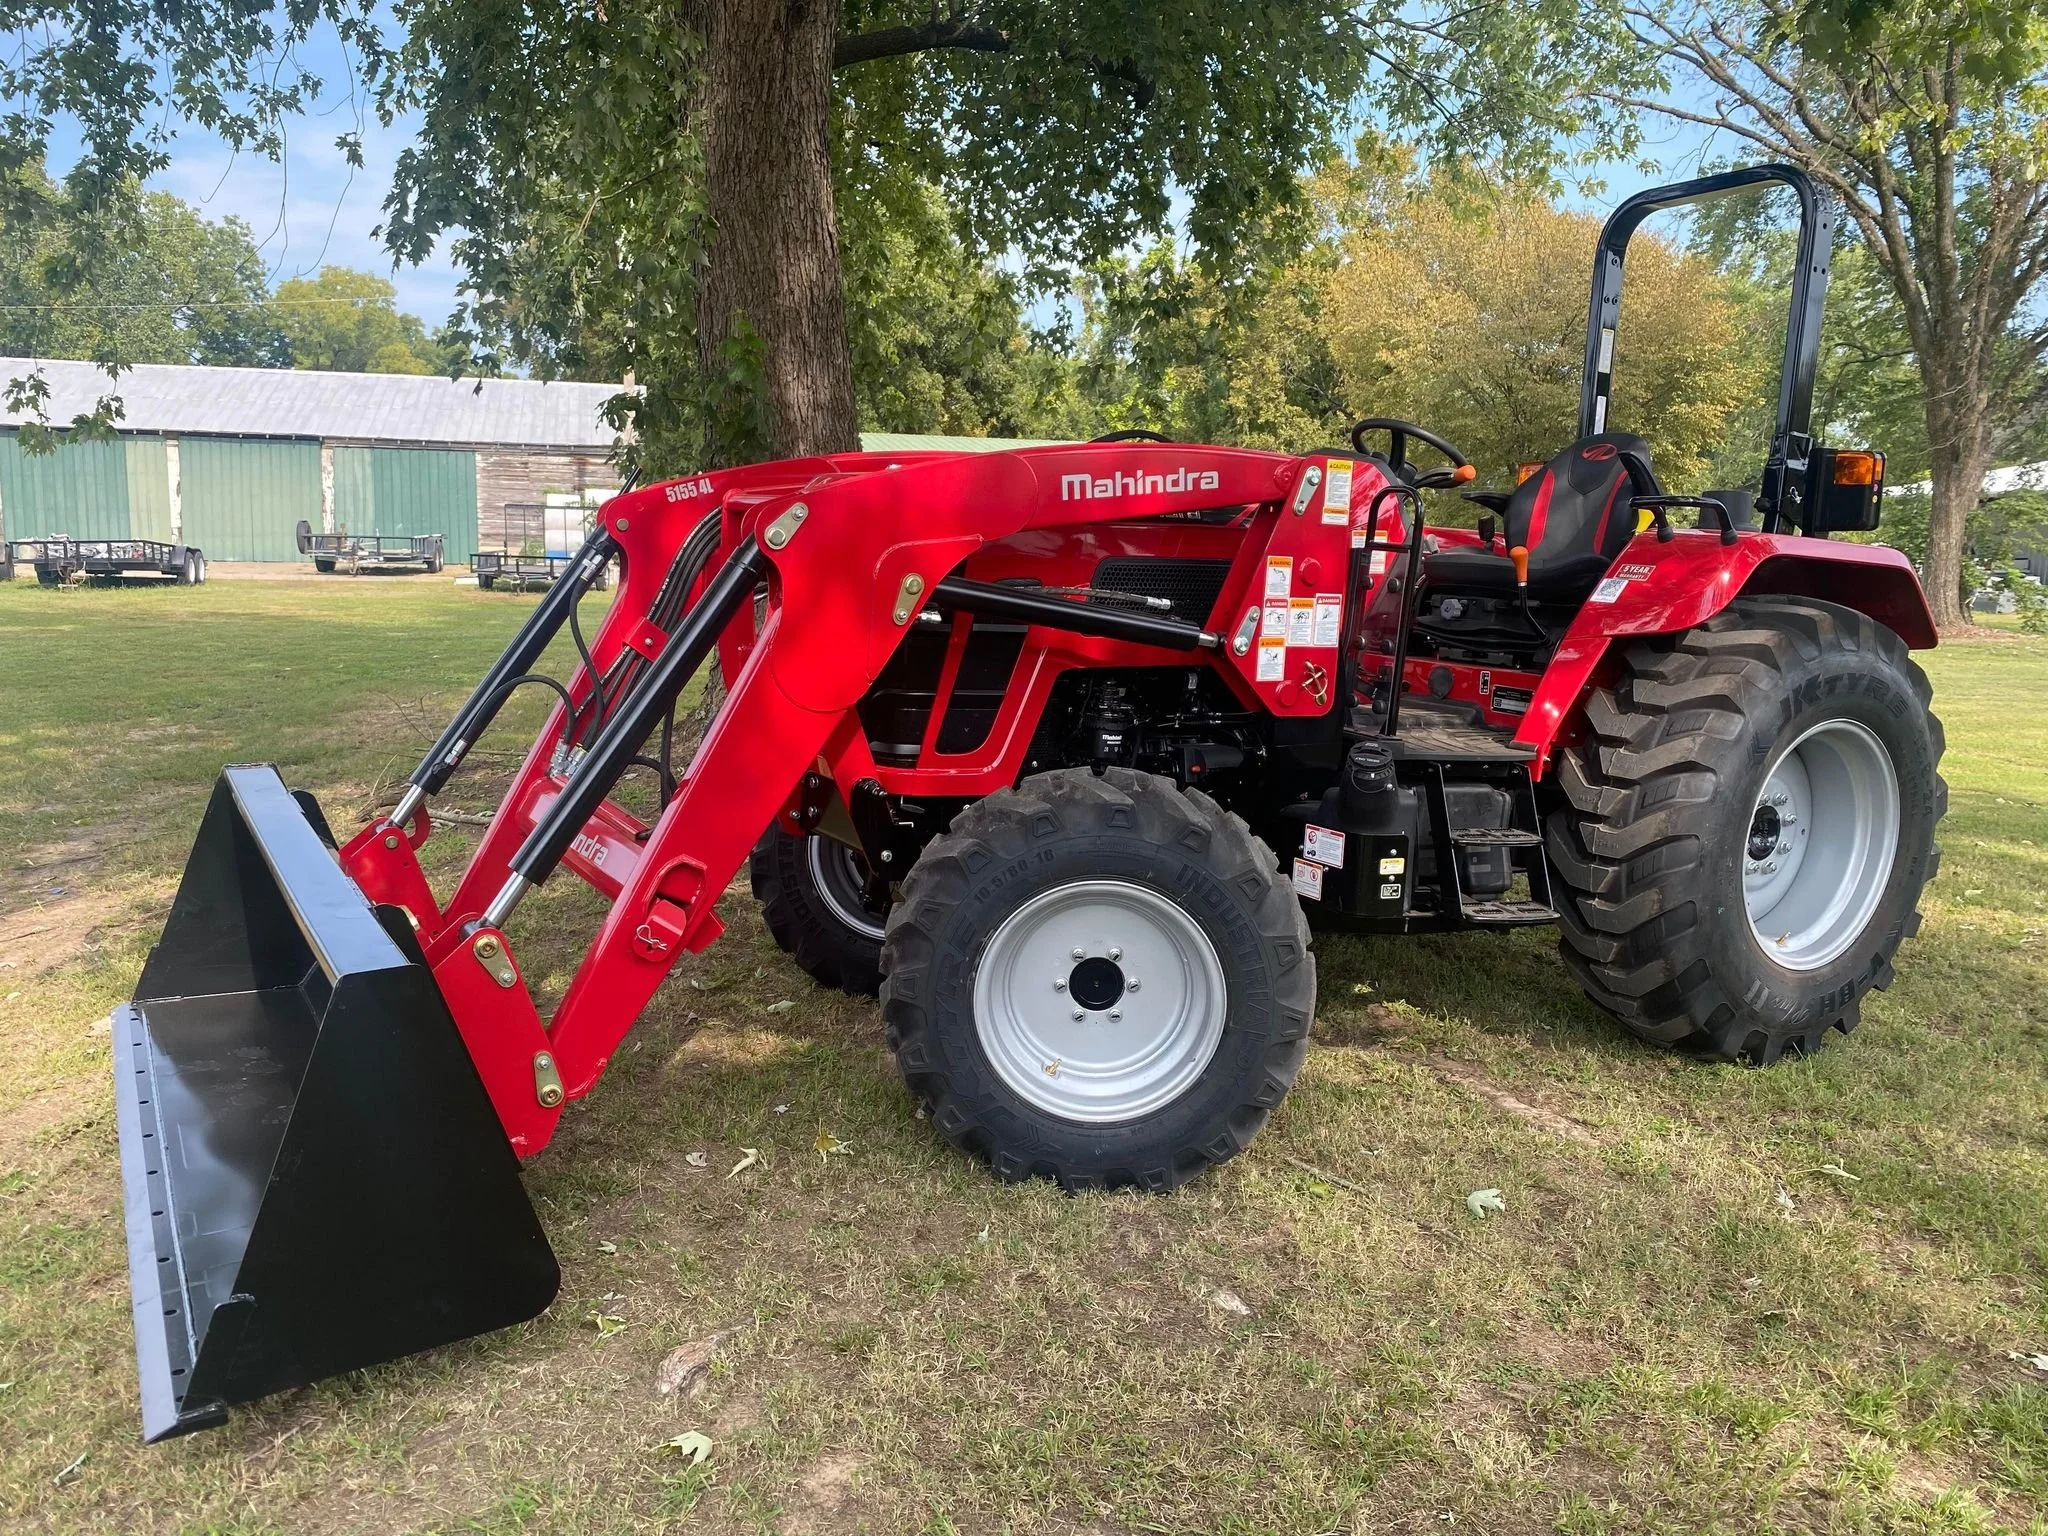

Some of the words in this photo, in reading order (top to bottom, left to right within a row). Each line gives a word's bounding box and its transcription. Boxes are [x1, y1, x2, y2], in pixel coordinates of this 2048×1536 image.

[665, 481, 698, 503] 5155
[699, 478, 715, 495] 4L
[1061, 467, 1219, 501] Mahindra
[1623, 565, 1631, 573] 5
[1629, 566, 1650, 574] YEAR
[1175, 862, 1270, 1043] INDUSTRIAL
